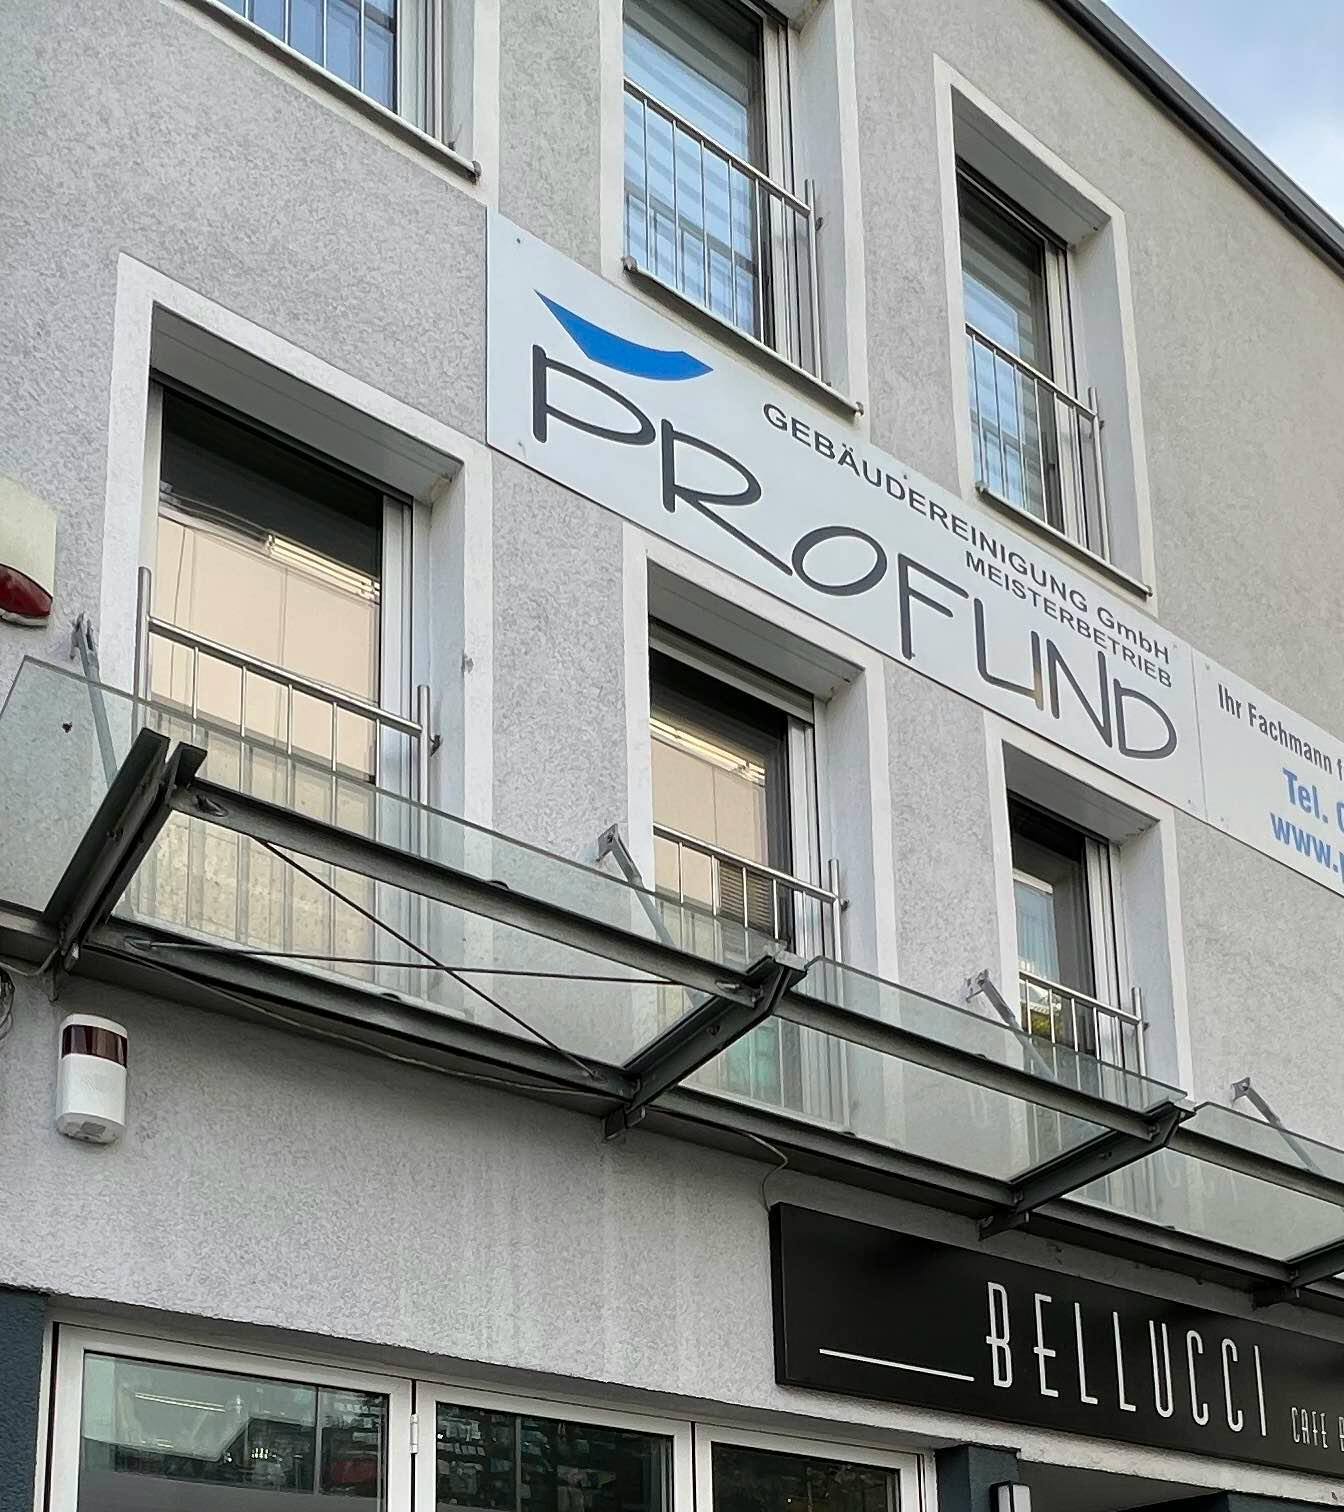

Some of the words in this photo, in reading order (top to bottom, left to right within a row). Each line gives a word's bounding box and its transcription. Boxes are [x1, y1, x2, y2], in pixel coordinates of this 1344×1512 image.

[532, 343, 1178, 761] PROFUND
[763, 402, 1088, 613] GEBÄUDEREINIGUNG
[1097, 606, 1170, 665] GmbH
[965, 550, 1173, 688] MEISTERBETRIEB
[1218, 682, 1242, 719] Ihr
[1248, 702, 1333, 775] Fachmann
[1282, 767, 1329, 824] Tel.
[985, 1280, 1268, 1437] BELLUCCI
[1291, 1407, 1329, 1449] CAFE
